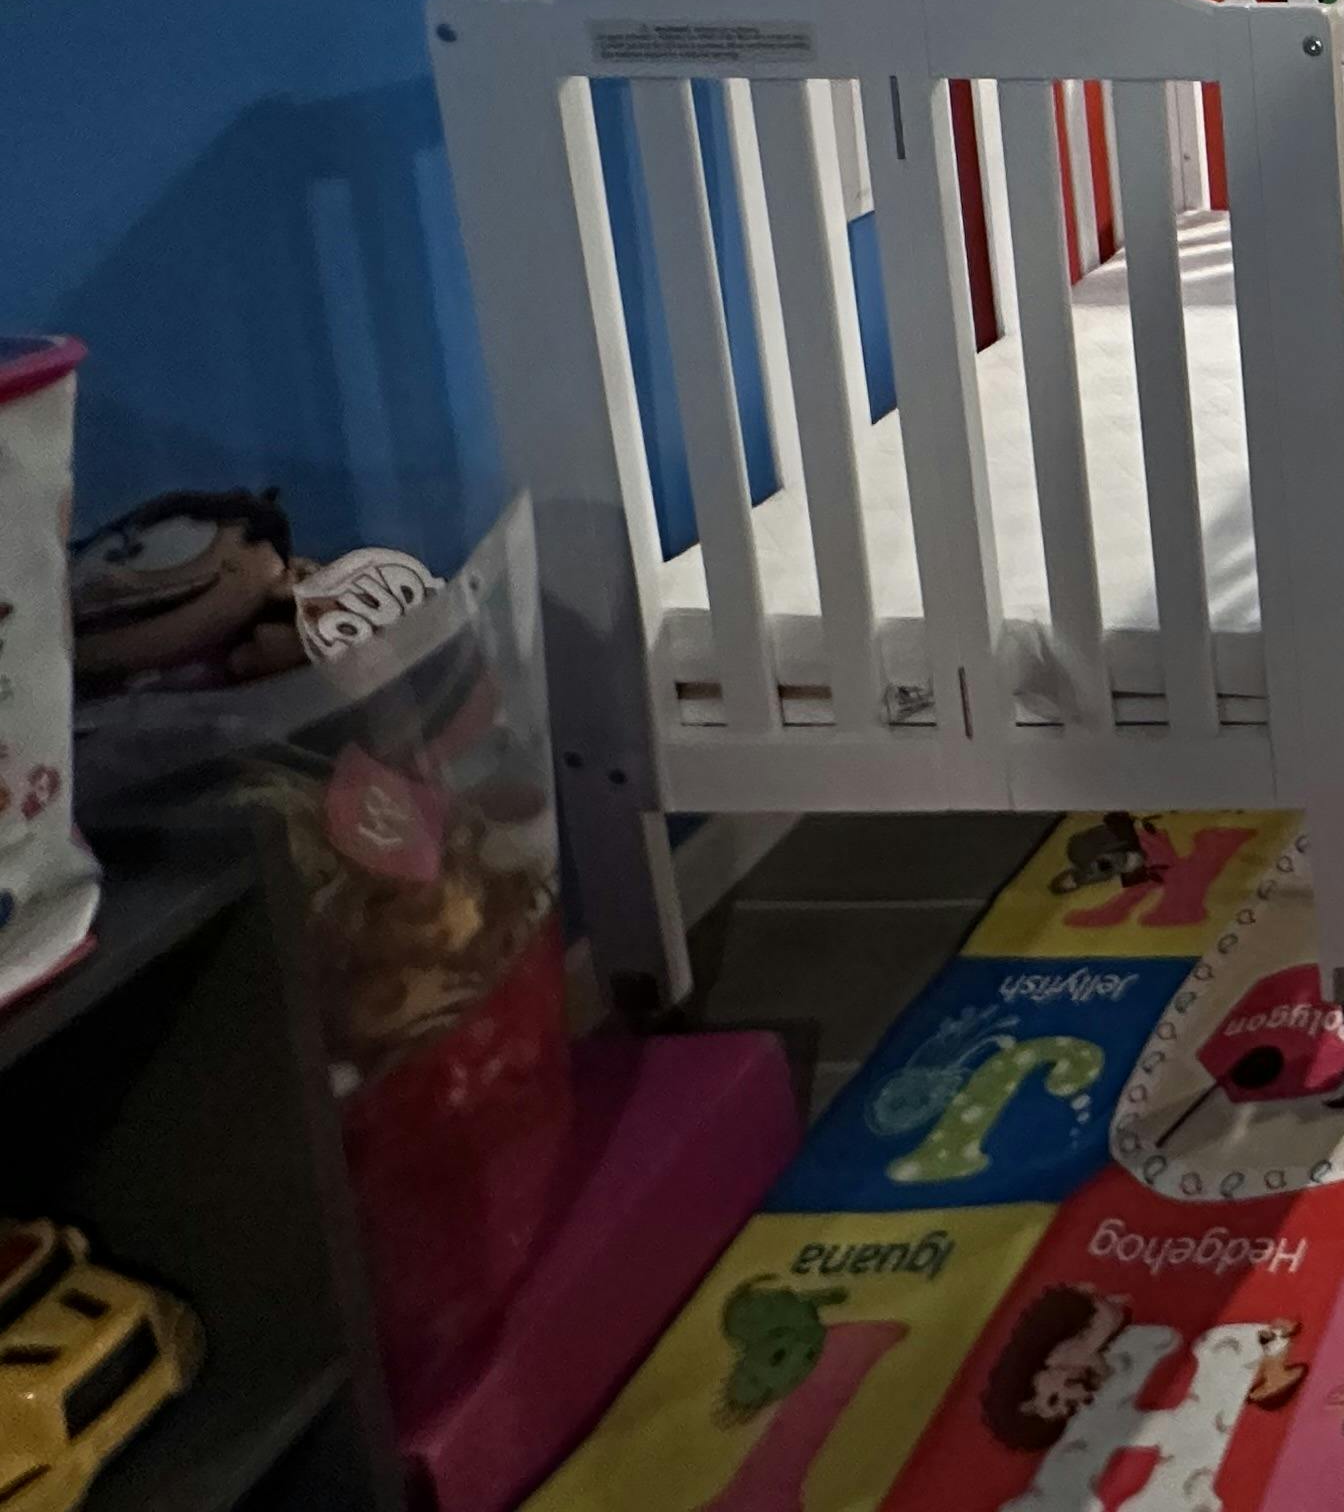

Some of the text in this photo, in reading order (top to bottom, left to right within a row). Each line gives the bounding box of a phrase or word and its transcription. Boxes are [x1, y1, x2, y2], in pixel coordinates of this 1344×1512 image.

[997, 969, 1140, 1004] Jellyfish
[791, 1238, 957, 1281] Iguana
[1088, 1219, 1310, 1273] Hedgehog
